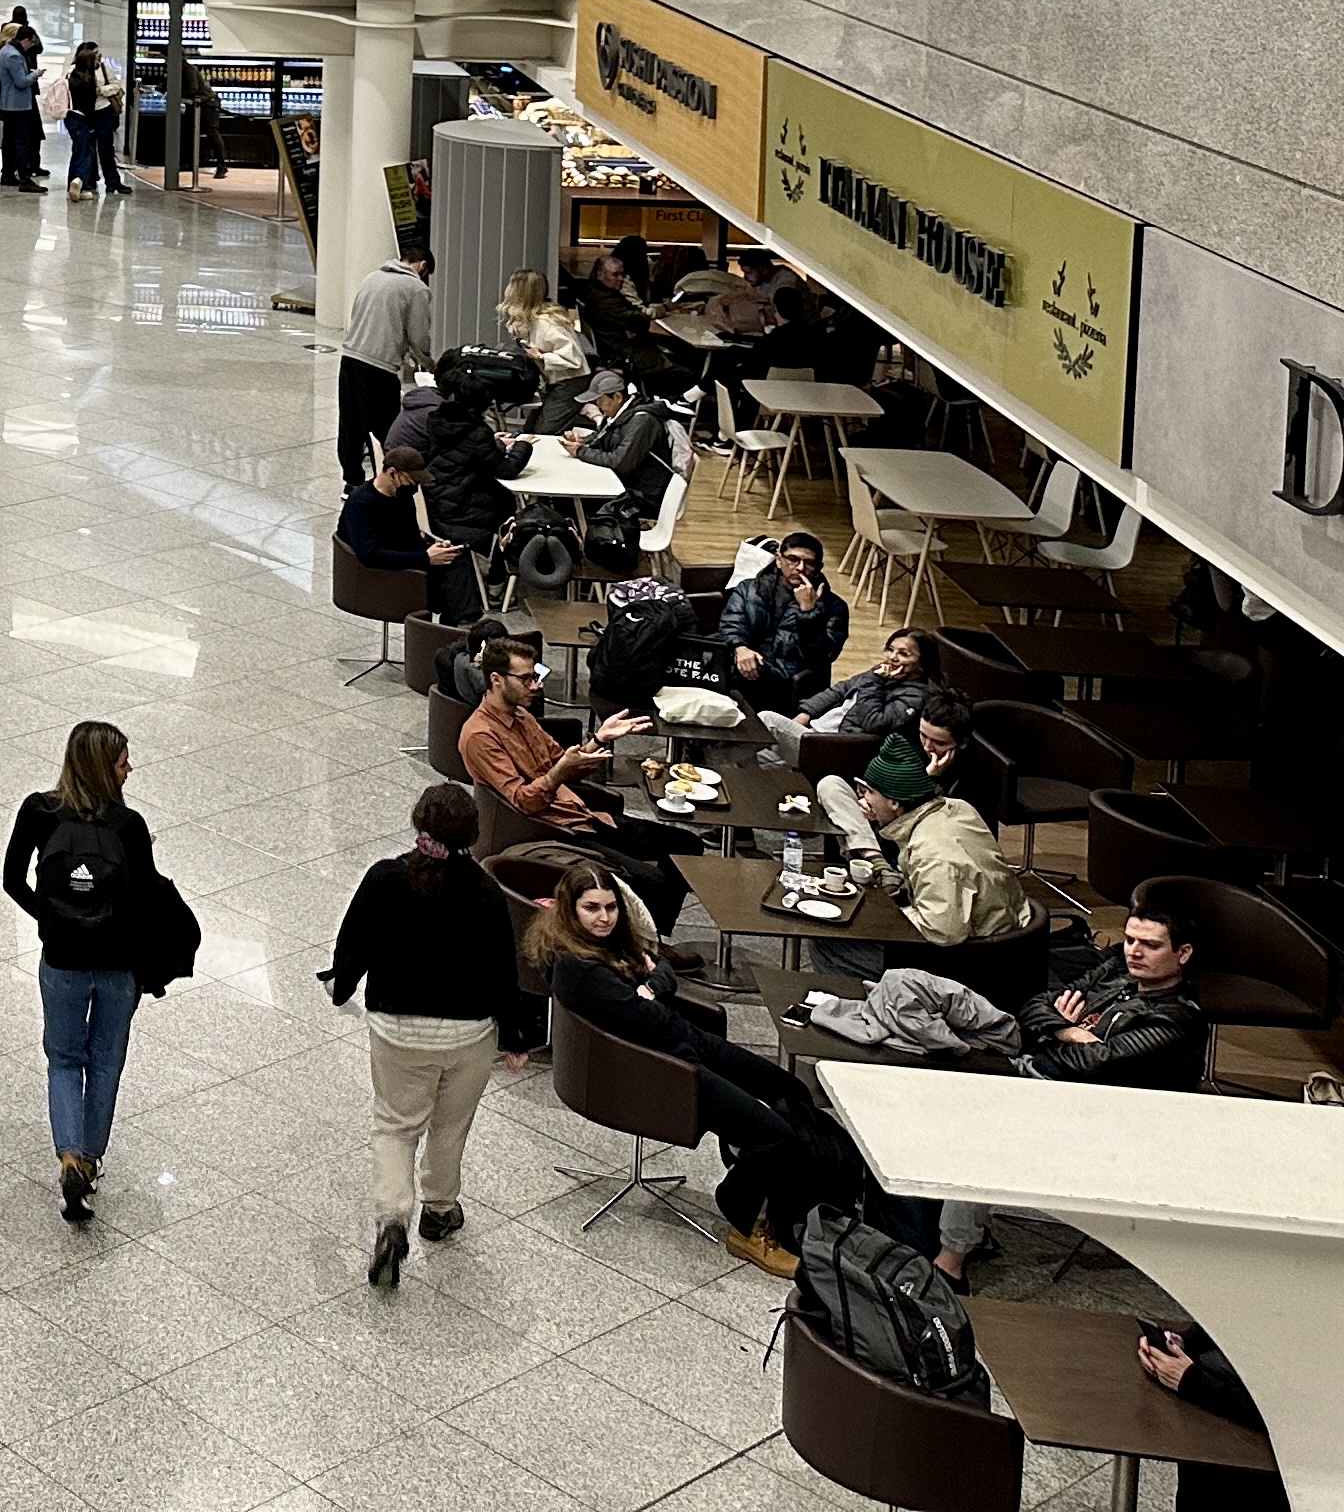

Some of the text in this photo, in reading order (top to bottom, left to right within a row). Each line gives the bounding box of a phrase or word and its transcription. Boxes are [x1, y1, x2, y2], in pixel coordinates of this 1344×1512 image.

[655, 210, 684, 222] First
[819, 156, 1010, 309] ITALIAN HOUSE
[675, 658, 701, 669] THE
[692, 671, 720, 683] BAG
